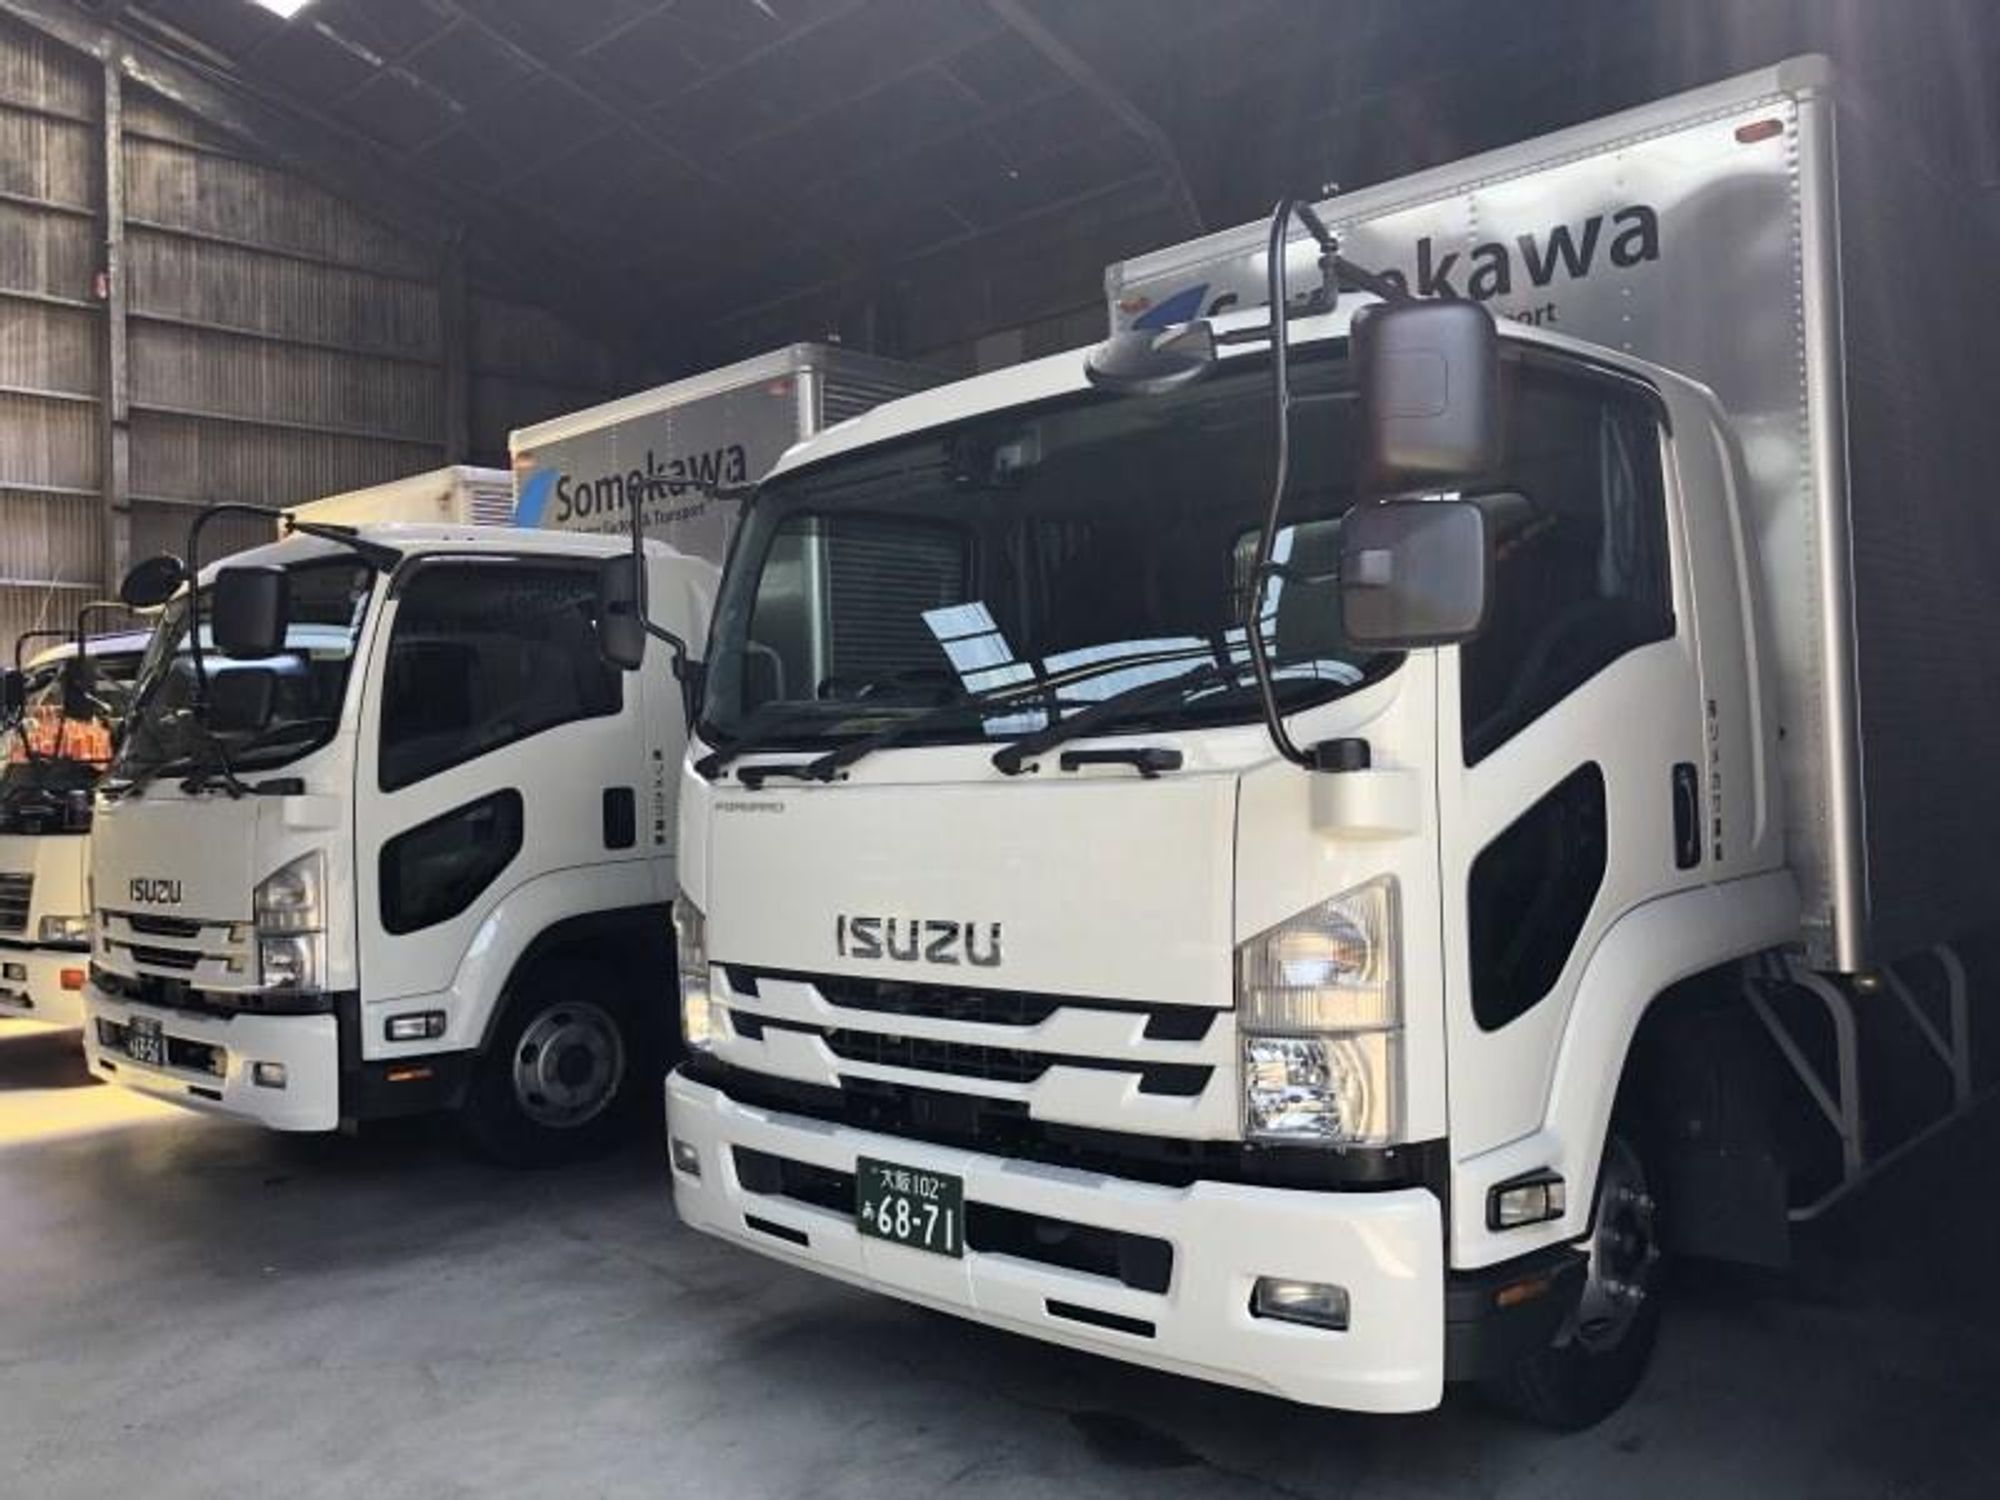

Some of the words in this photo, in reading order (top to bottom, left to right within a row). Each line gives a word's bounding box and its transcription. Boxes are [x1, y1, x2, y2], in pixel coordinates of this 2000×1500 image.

[557, 444, 747, 522] Somekawa
[130, 880, 182, 904] ISUZU
[837, 914, 1002, 967] ISUZU
[879, 1169, 911, 1193] 大阪
[913, 1174, 940, 1200] 102
[877, 1194, 954, 1251] 68-71
